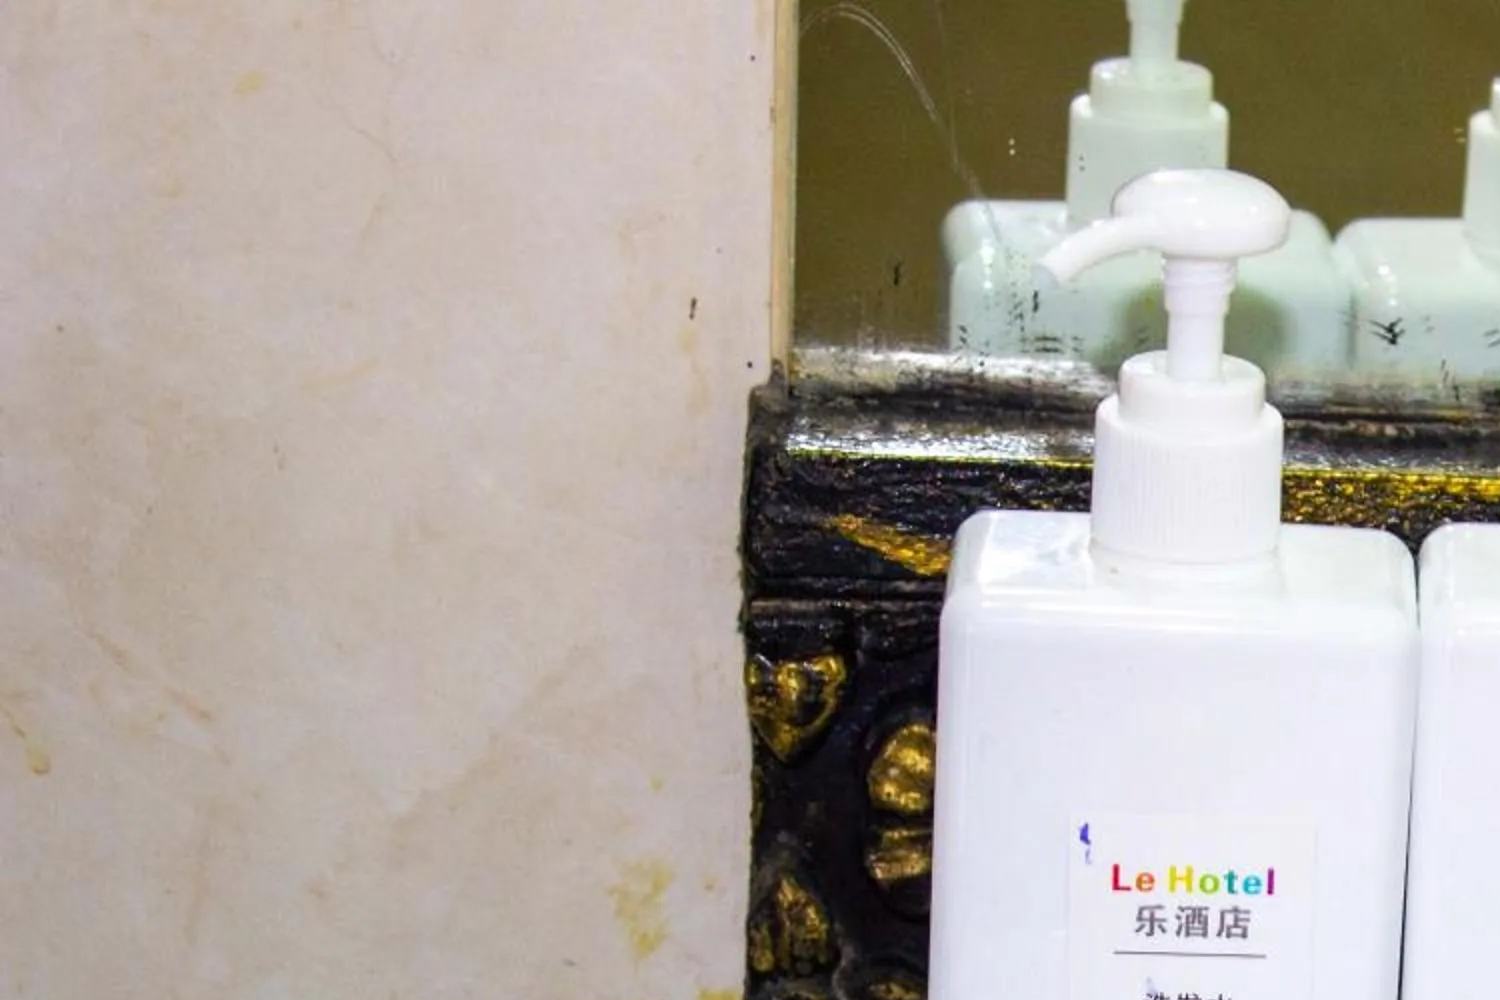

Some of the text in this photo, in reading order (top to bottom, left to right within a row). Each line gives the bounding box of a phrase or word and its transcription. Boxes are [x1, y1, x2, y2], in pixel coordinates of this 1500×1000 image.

[1111, 863, 1276, 896] Le Hotel
[1134, 904, 1252, 940] 乐酒店
